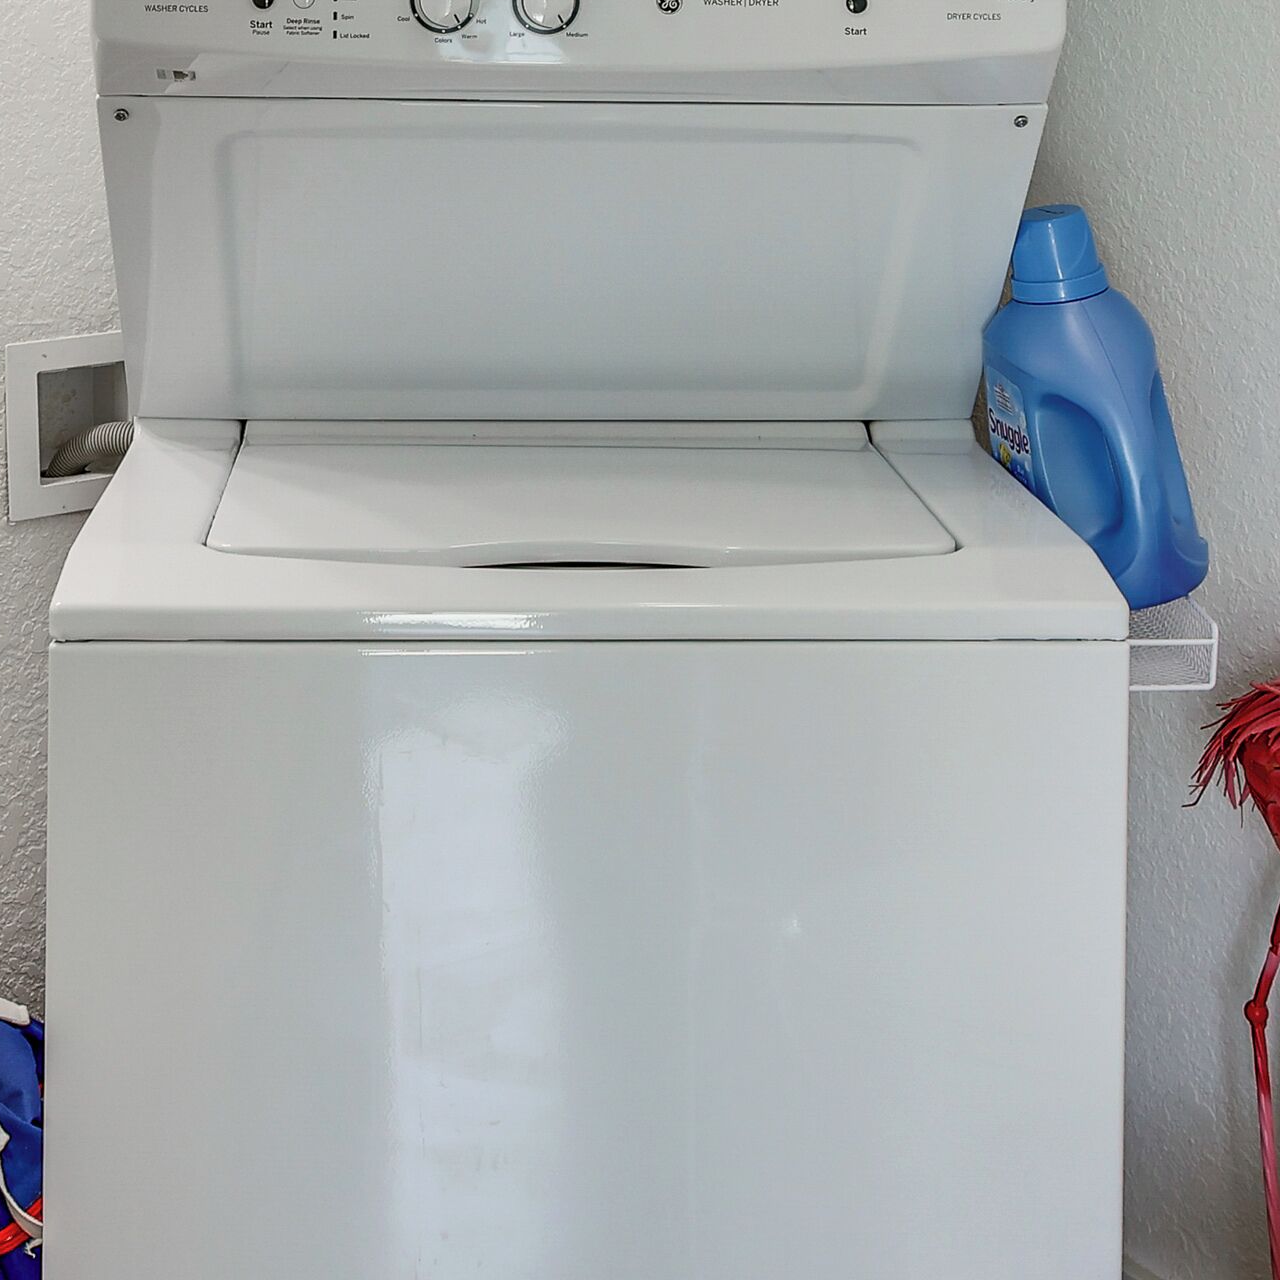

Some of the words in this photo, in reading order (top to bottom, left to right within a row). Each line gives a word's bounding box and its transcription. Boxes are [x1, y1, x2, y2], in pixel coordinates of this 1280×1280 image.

[947, 13, 971, 21] DRYER
[973, 13, 1001, 21] CYCLES
[250, 20, 272, 28] Start
[844, 27, 867, 35] Start
[988, 408, 1030, 455] Snuggle
